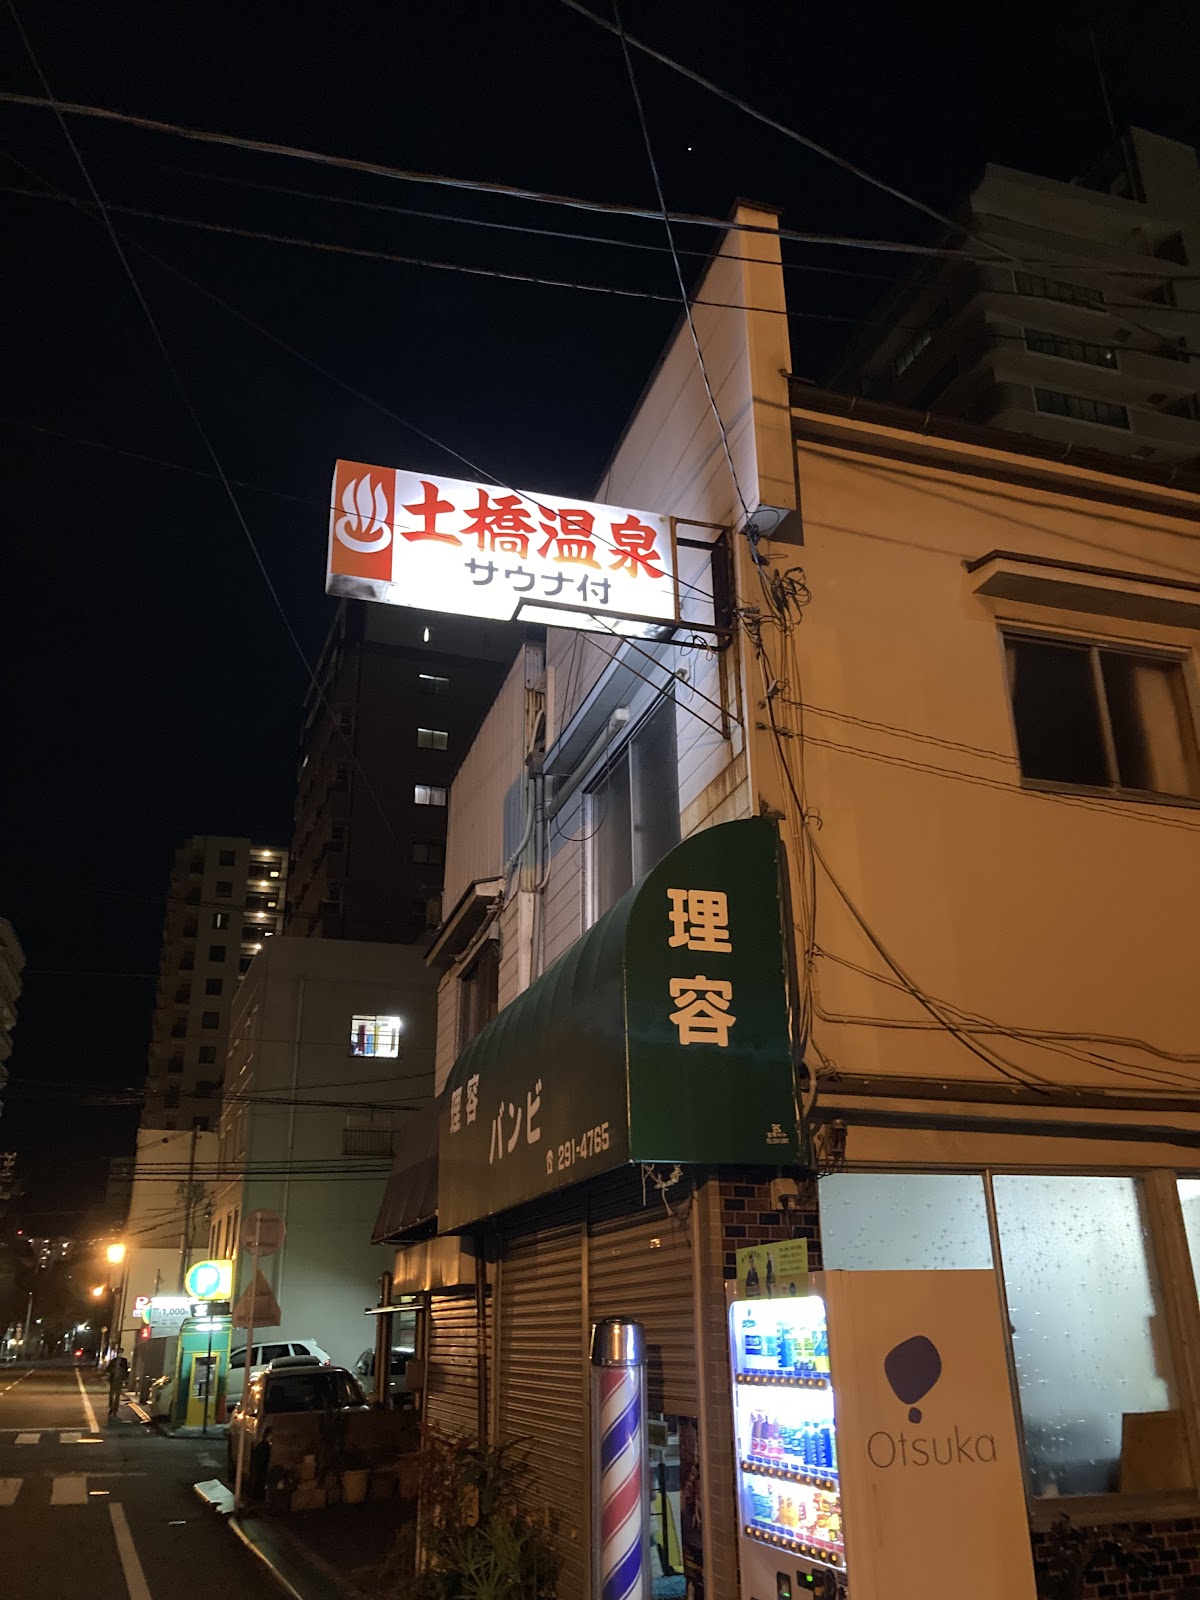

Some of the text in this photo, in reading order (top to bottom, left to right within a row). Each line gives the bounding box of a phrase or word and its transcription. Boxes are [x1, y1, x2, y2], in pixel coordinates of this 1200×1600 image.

[401, 481, 666, 579] 土橋温泉
[465, 557, 611, 604] サウナ付
[666, 888, 735, 1047] 理容
[450, 1073, 480, 1134] 理容
[489, 1078, 542, 1165] バンビ
[558, 1121, 610, 1171] 291-4765
[197, 1268, 218, 1293] P
[868, 1425, 997, 1469] Otsuka
